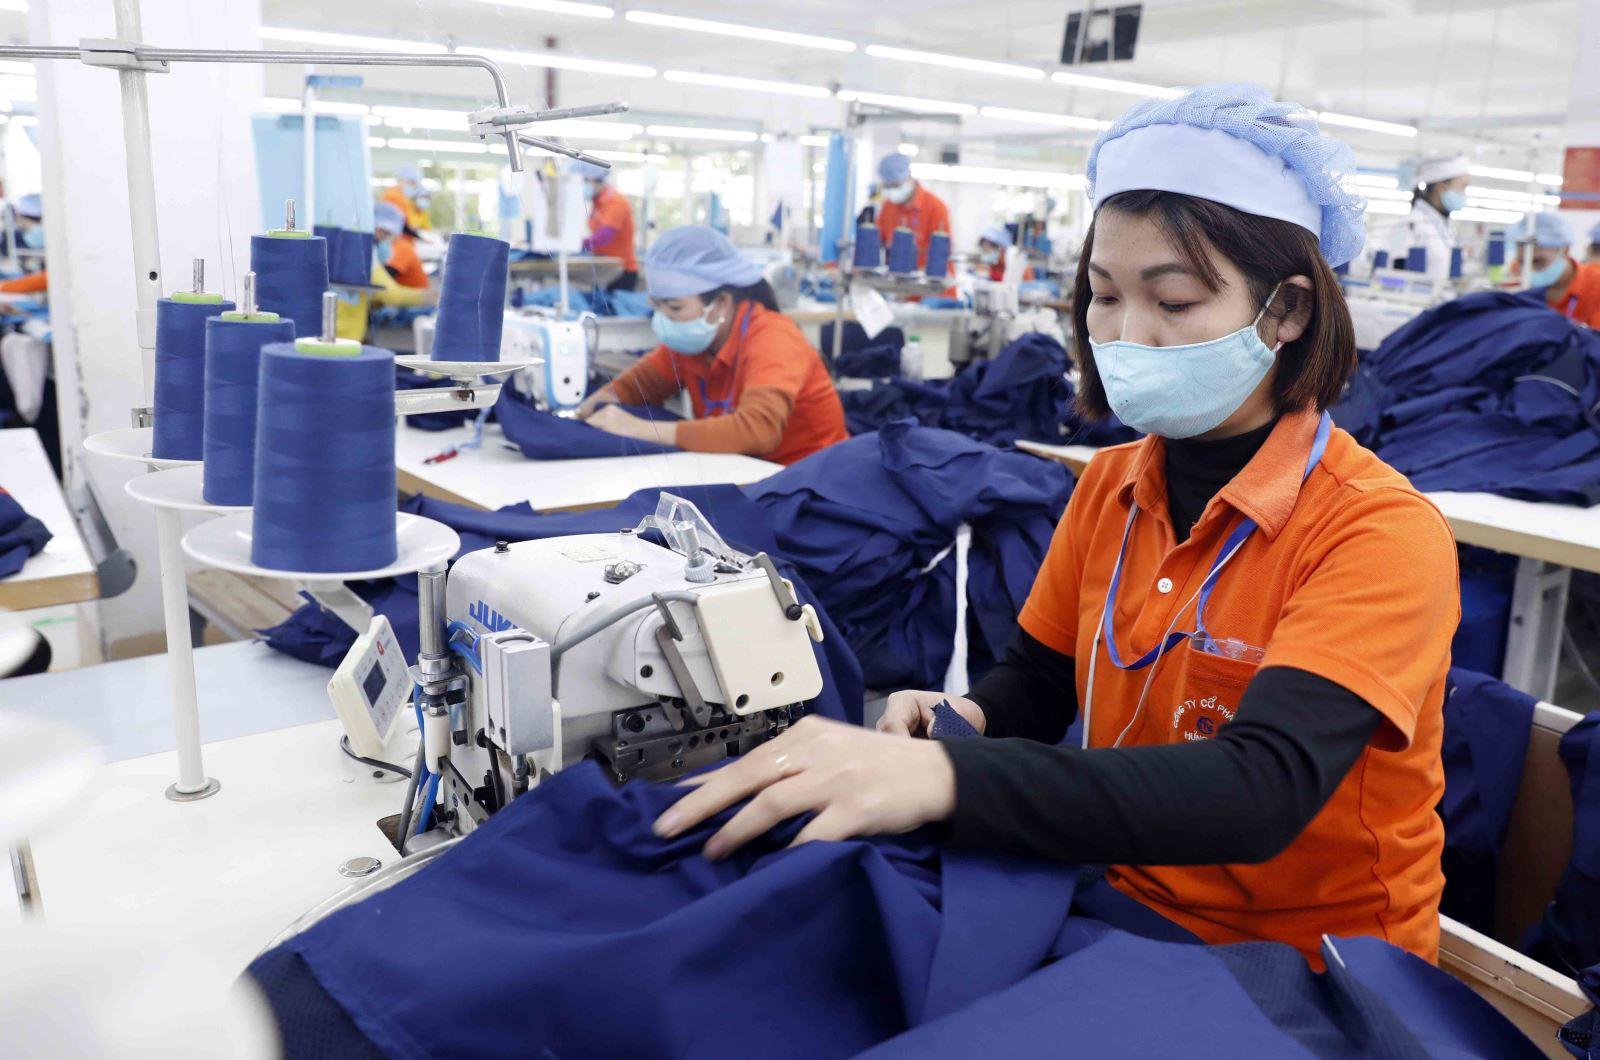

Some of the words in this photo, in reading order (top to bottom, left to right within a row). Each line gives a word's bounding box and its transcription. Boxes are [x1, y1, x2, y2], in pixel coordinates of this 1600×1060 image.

[469, 600, 518, 632] JUK
[1184, 699, 1196, 709] TY
[1200, 696, 1217, 709] CỔ
